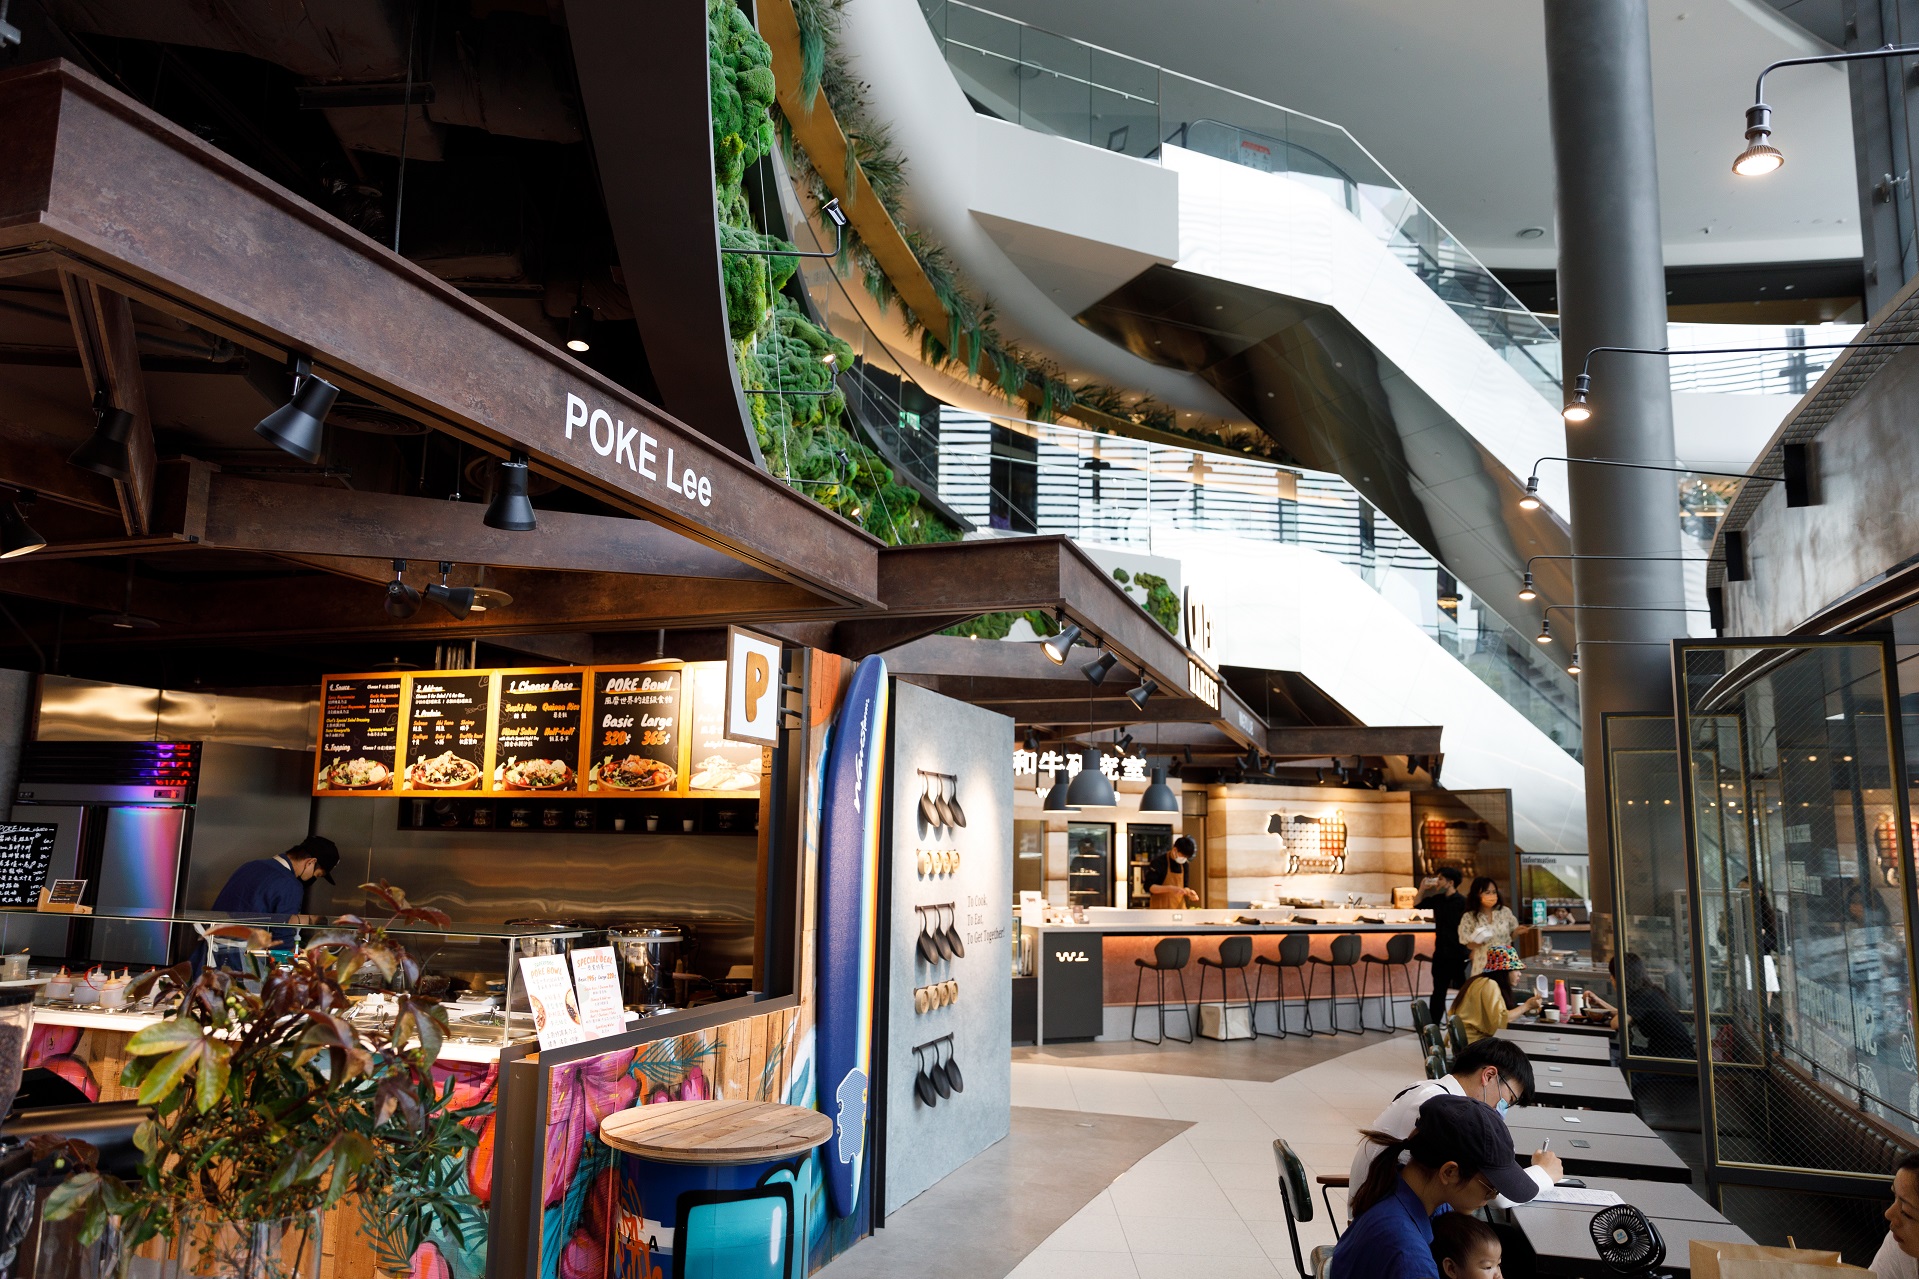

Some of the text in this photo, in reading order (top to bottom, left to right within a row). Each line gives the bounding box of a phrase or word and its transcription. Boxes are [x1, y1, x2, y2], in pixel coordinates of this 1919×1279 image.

[565, 392, 712, 507] POKE Lee
[518, 680, 550, 692] Choose
[552, 680, 574, 691] Base
[605, 676, 673, 692] POKE Bowl
[745, 651, 769, 722] P
[505, 703, 538, 712] Sushi Rice
[542, 702, 580, 712] Quinoa Rice
[602, 713, 673, 730] Basic Large
[331, 744, 351, 752] Topping
[967, 896, 973, 907] To
[967, 914, 973, 926] To
[967, 932, 973, 945] To
[577, 955, 599, 967] SPECIAL
